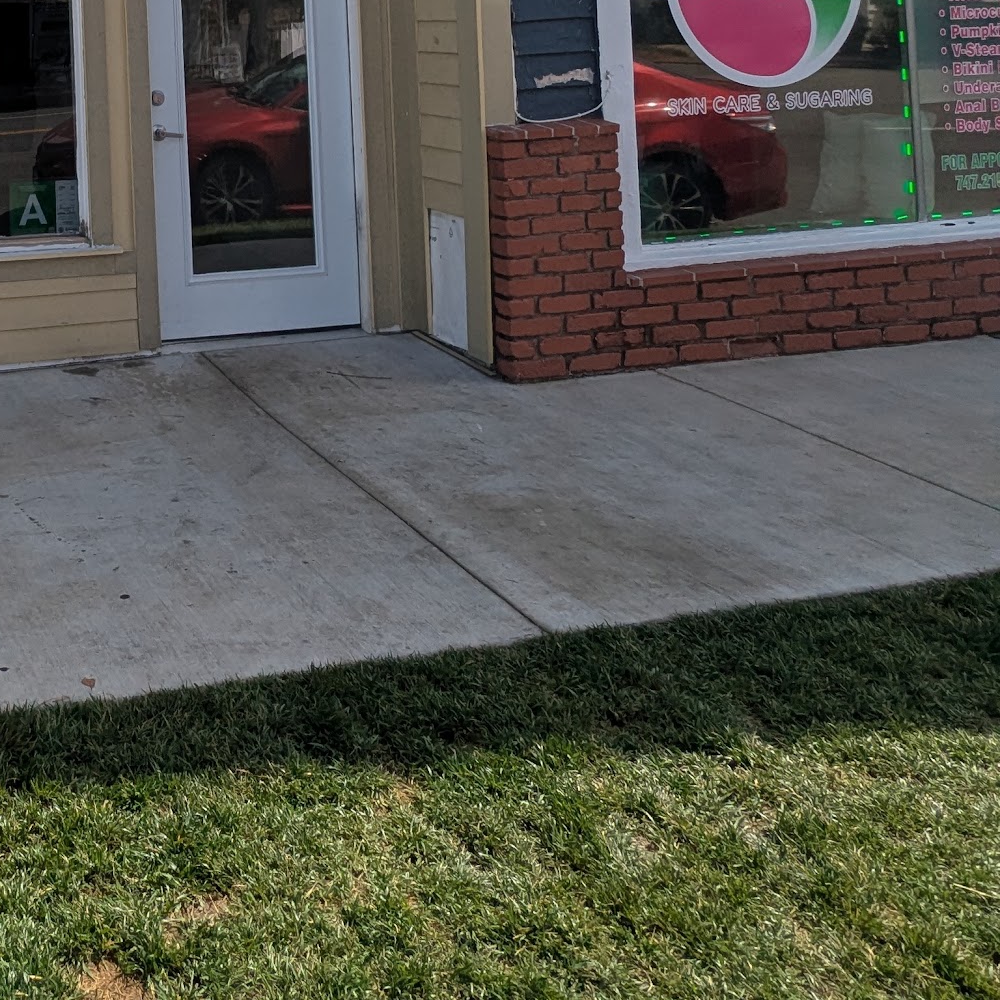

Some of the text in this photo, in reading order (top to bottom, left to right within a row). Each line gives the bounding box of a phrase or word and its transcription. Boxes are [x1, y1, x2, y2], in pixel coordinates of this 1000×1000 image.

[952, 42, 1000, 57] V-Stea
[953, 60, 994, 76] Bikini
[667, 88, 873, 116] SKIN CARE & SUGARING
[955, 98, 987, 114] Anal
[956, 117, 990, 134] Body
[941, 154, 967, 171] FOR
[19, 193, 47, 226] A
